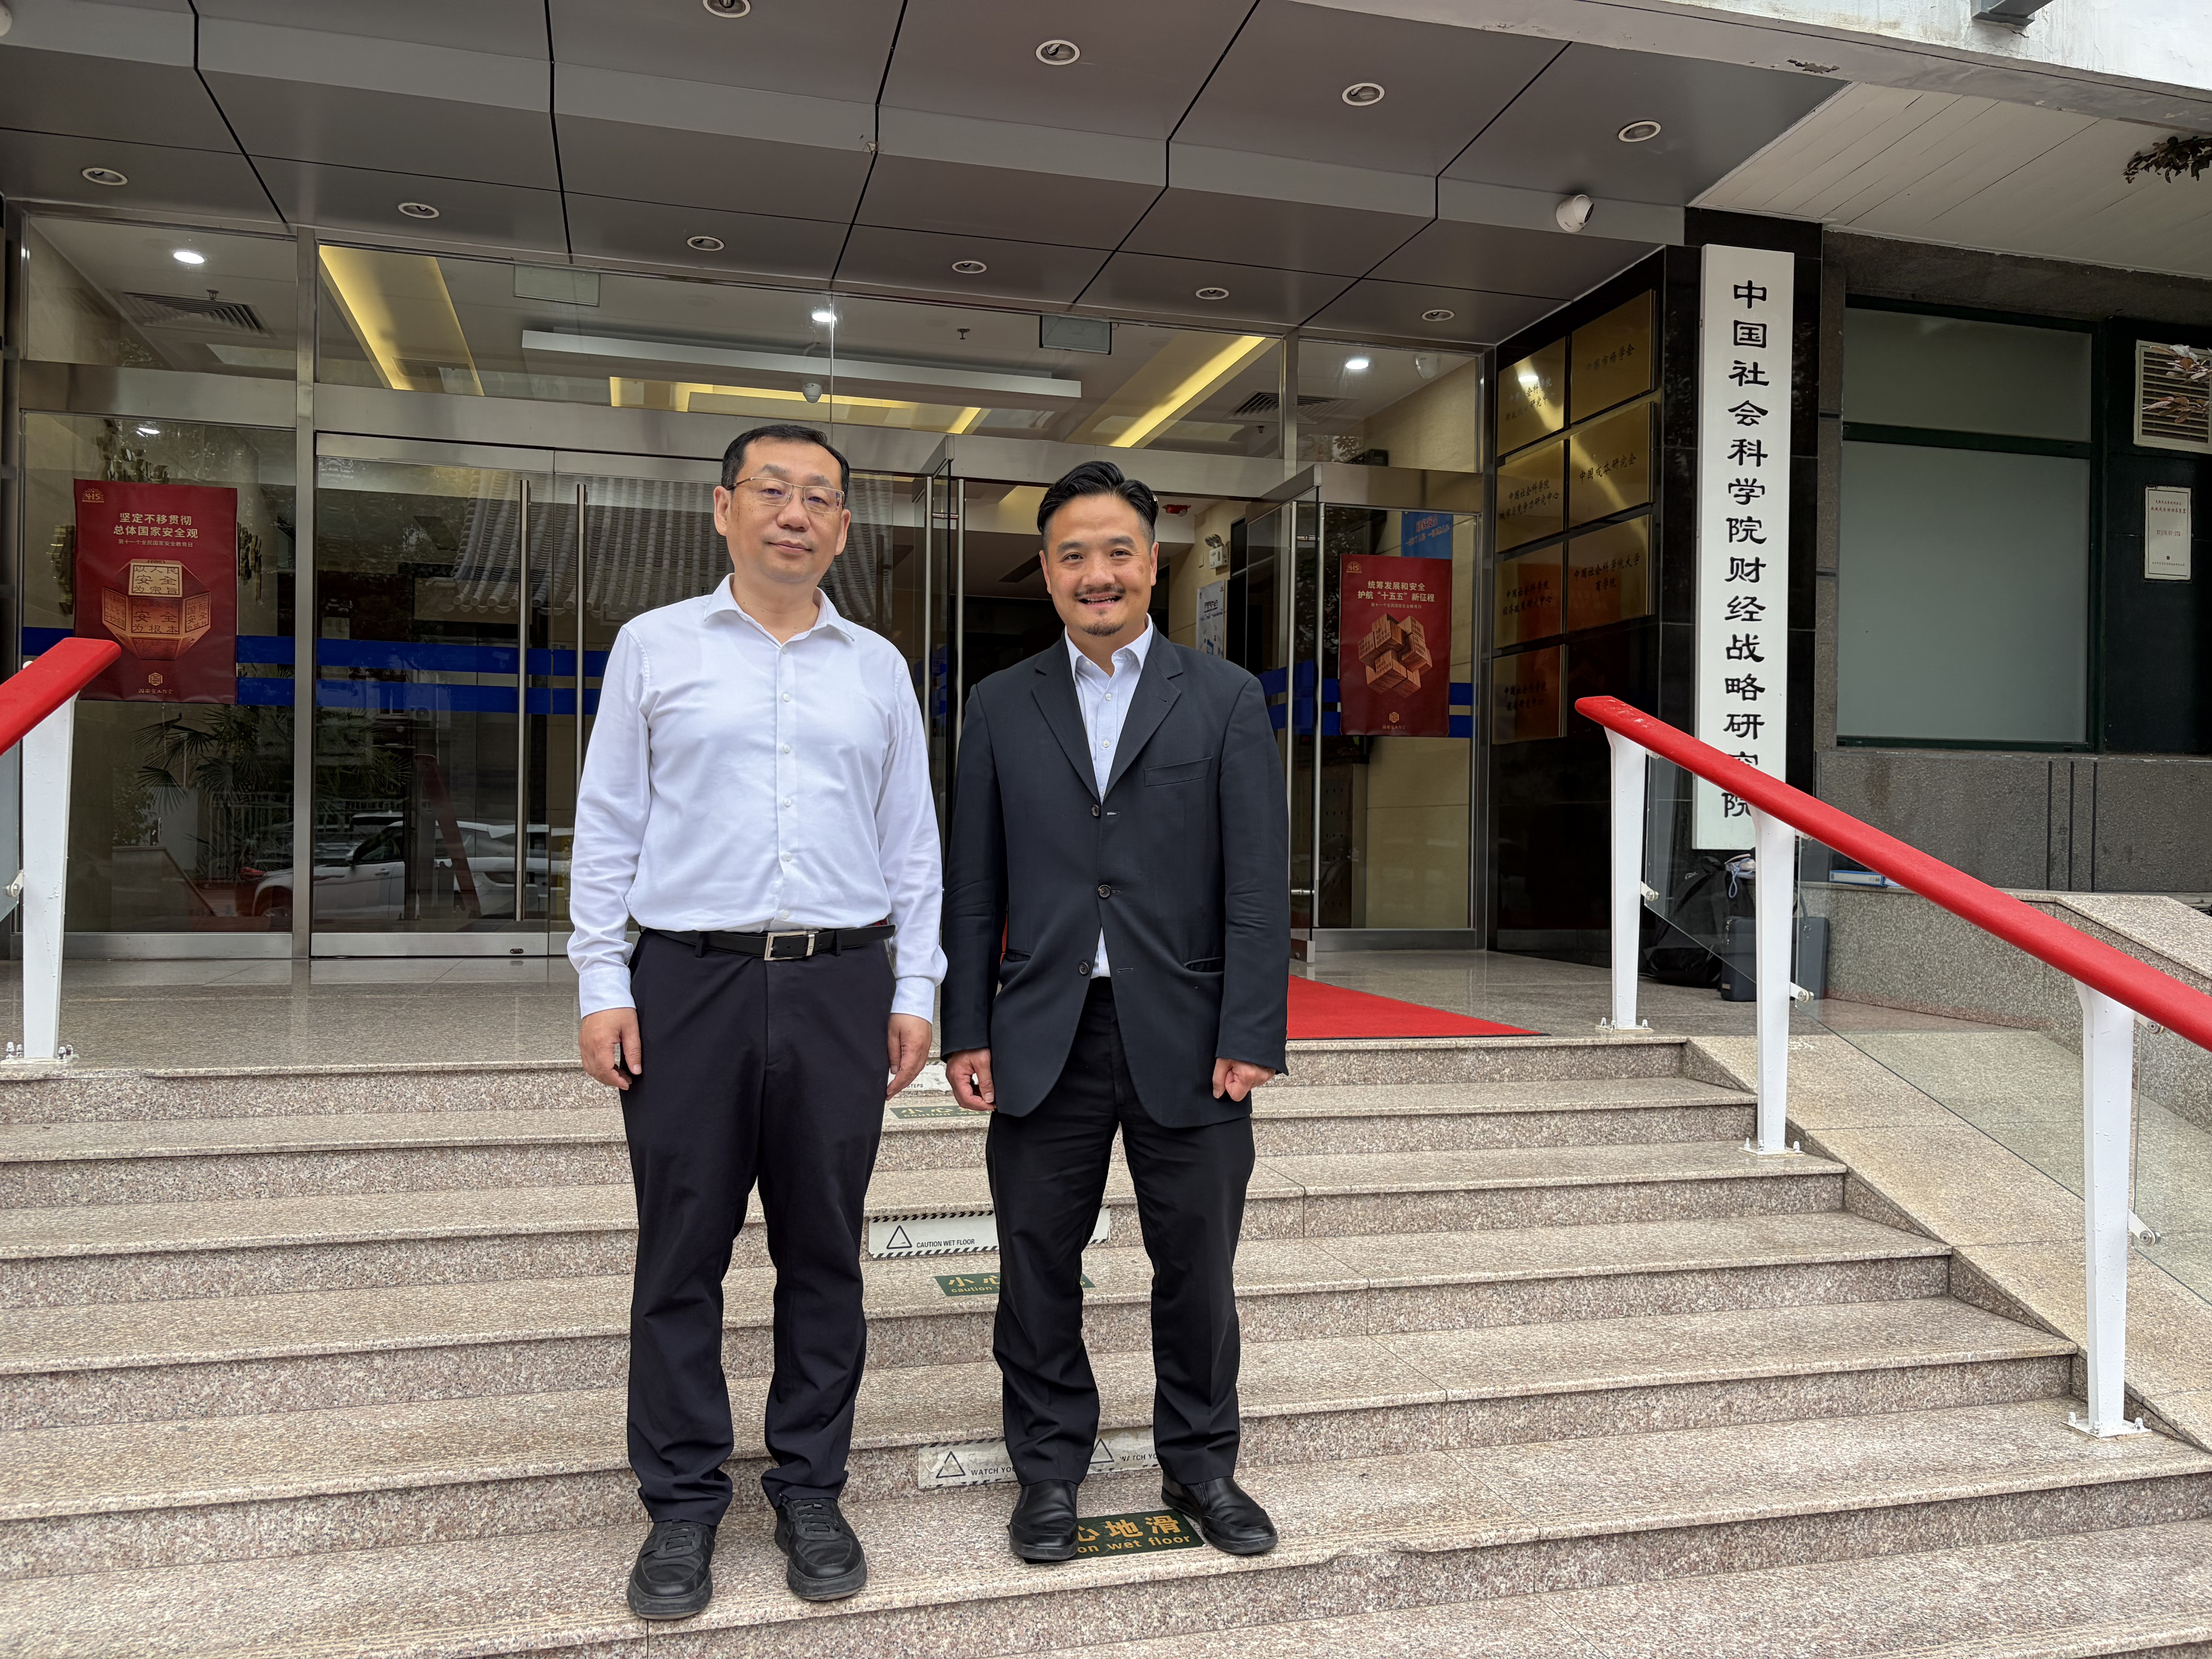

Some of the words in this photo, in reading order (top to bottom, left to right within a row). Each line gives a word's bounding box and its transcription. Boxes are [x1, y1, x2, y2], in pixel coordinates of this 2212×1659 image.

[119, 512, 192, 526] 坚定不移贯彻
[113, 525, 198, 539] 总体国家安全观
[118, 539, 193, 547] 第十一个全民国家安全教育日
[134, 565, 179, 575] 以人民
[134, 575, 177, 586] 安全
[1368, 580, 1425, 591] 统筹发展和安全
[134, 610, 178, 623] 安全
[132, 624, 178, 634] 为根本
[971, 1467, 999, 1476] WATCH
[1106, 1539, 1142, 1550] wet
[1148, 1535, 1190, 1546] floor
